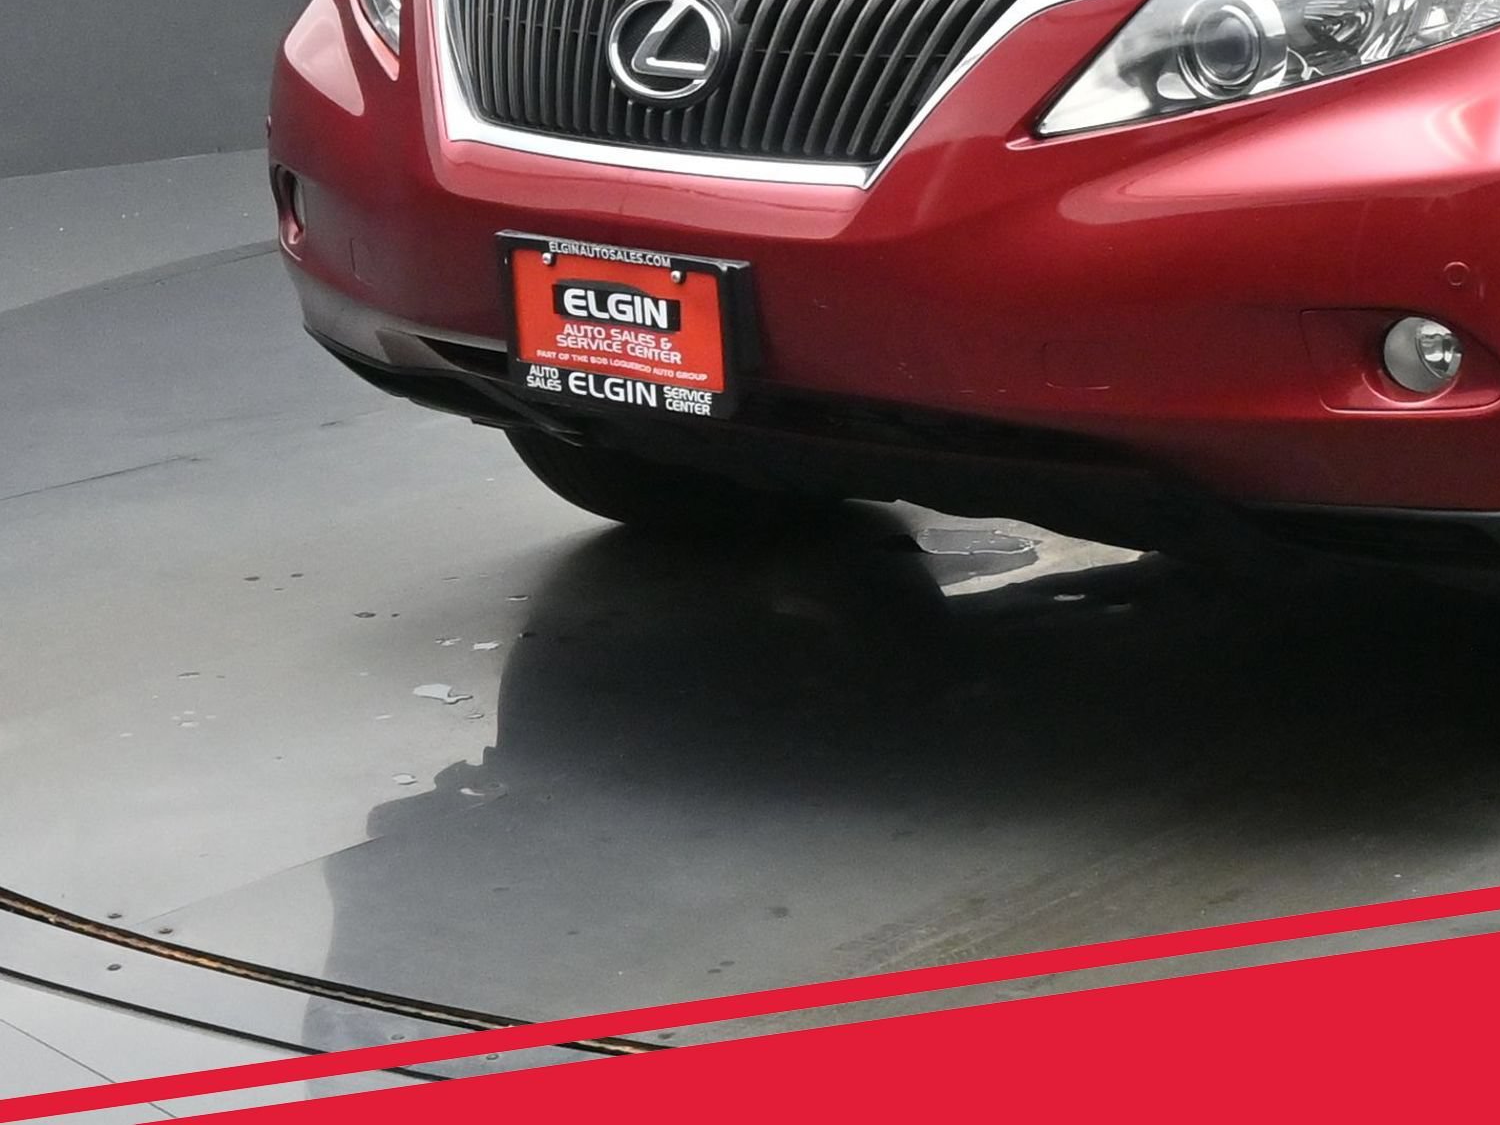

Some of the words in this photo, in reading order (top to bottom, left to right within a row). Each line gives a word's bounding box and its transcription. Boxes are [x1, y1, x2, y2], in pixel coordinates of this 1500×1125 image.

[549, 241, 672, 269] ELGINAUTOSALES.COM
[563, 287, 668, 329] ELGIN
[556, 334, 622, 353] SERVICE
[626, 344, 682, 365] CENTER
[563, 324, 605, 339] AUTO
[610, 328, 656, 348] SALES
[660, 337, 672, 350] &
[529, 365, 559, 379] AUTO
[536, 349, 556, 359] PART
[558, 352, 570, 361] OF
[571, 354, 589, 363] THE
[653, 367, 674, 378] AUTO
[526, 376, 562, 392] SALES
[568, 372, 657, 407] ELGIN
[663, 386, 713, 404] SERVICE
[665, 399, 711, 416] CENTER
